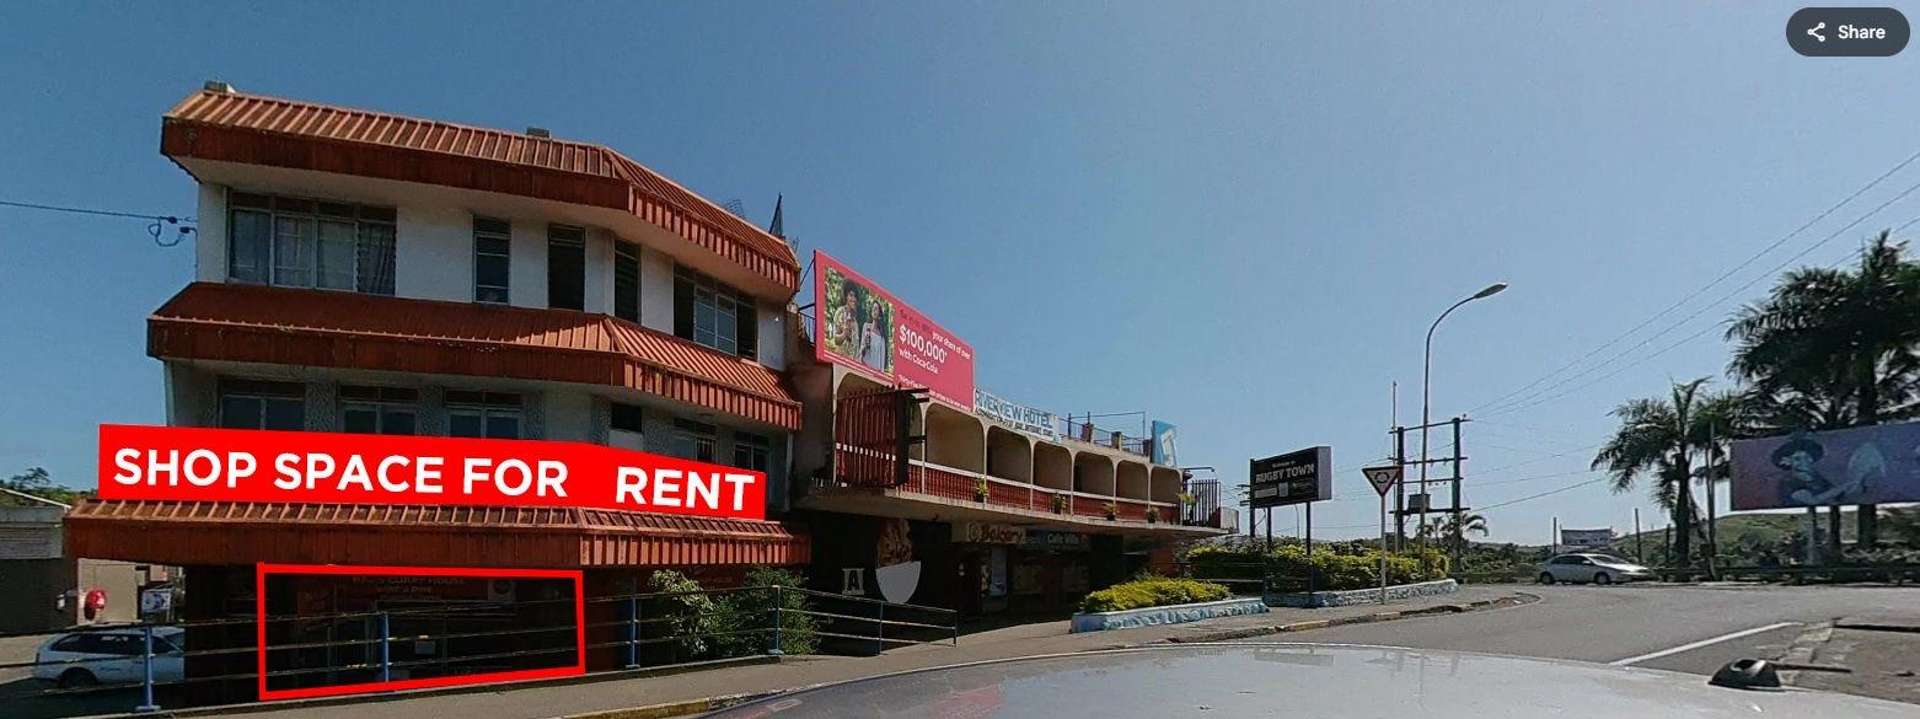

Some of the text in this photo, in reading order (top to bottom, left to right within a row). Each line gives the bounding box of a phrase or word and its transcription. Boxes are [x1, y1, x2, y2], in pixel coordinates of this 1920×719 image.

[1023, 406, 1053, 428] HOTEL
[1255, 463, 1315, 484] RUGBY TOWN
